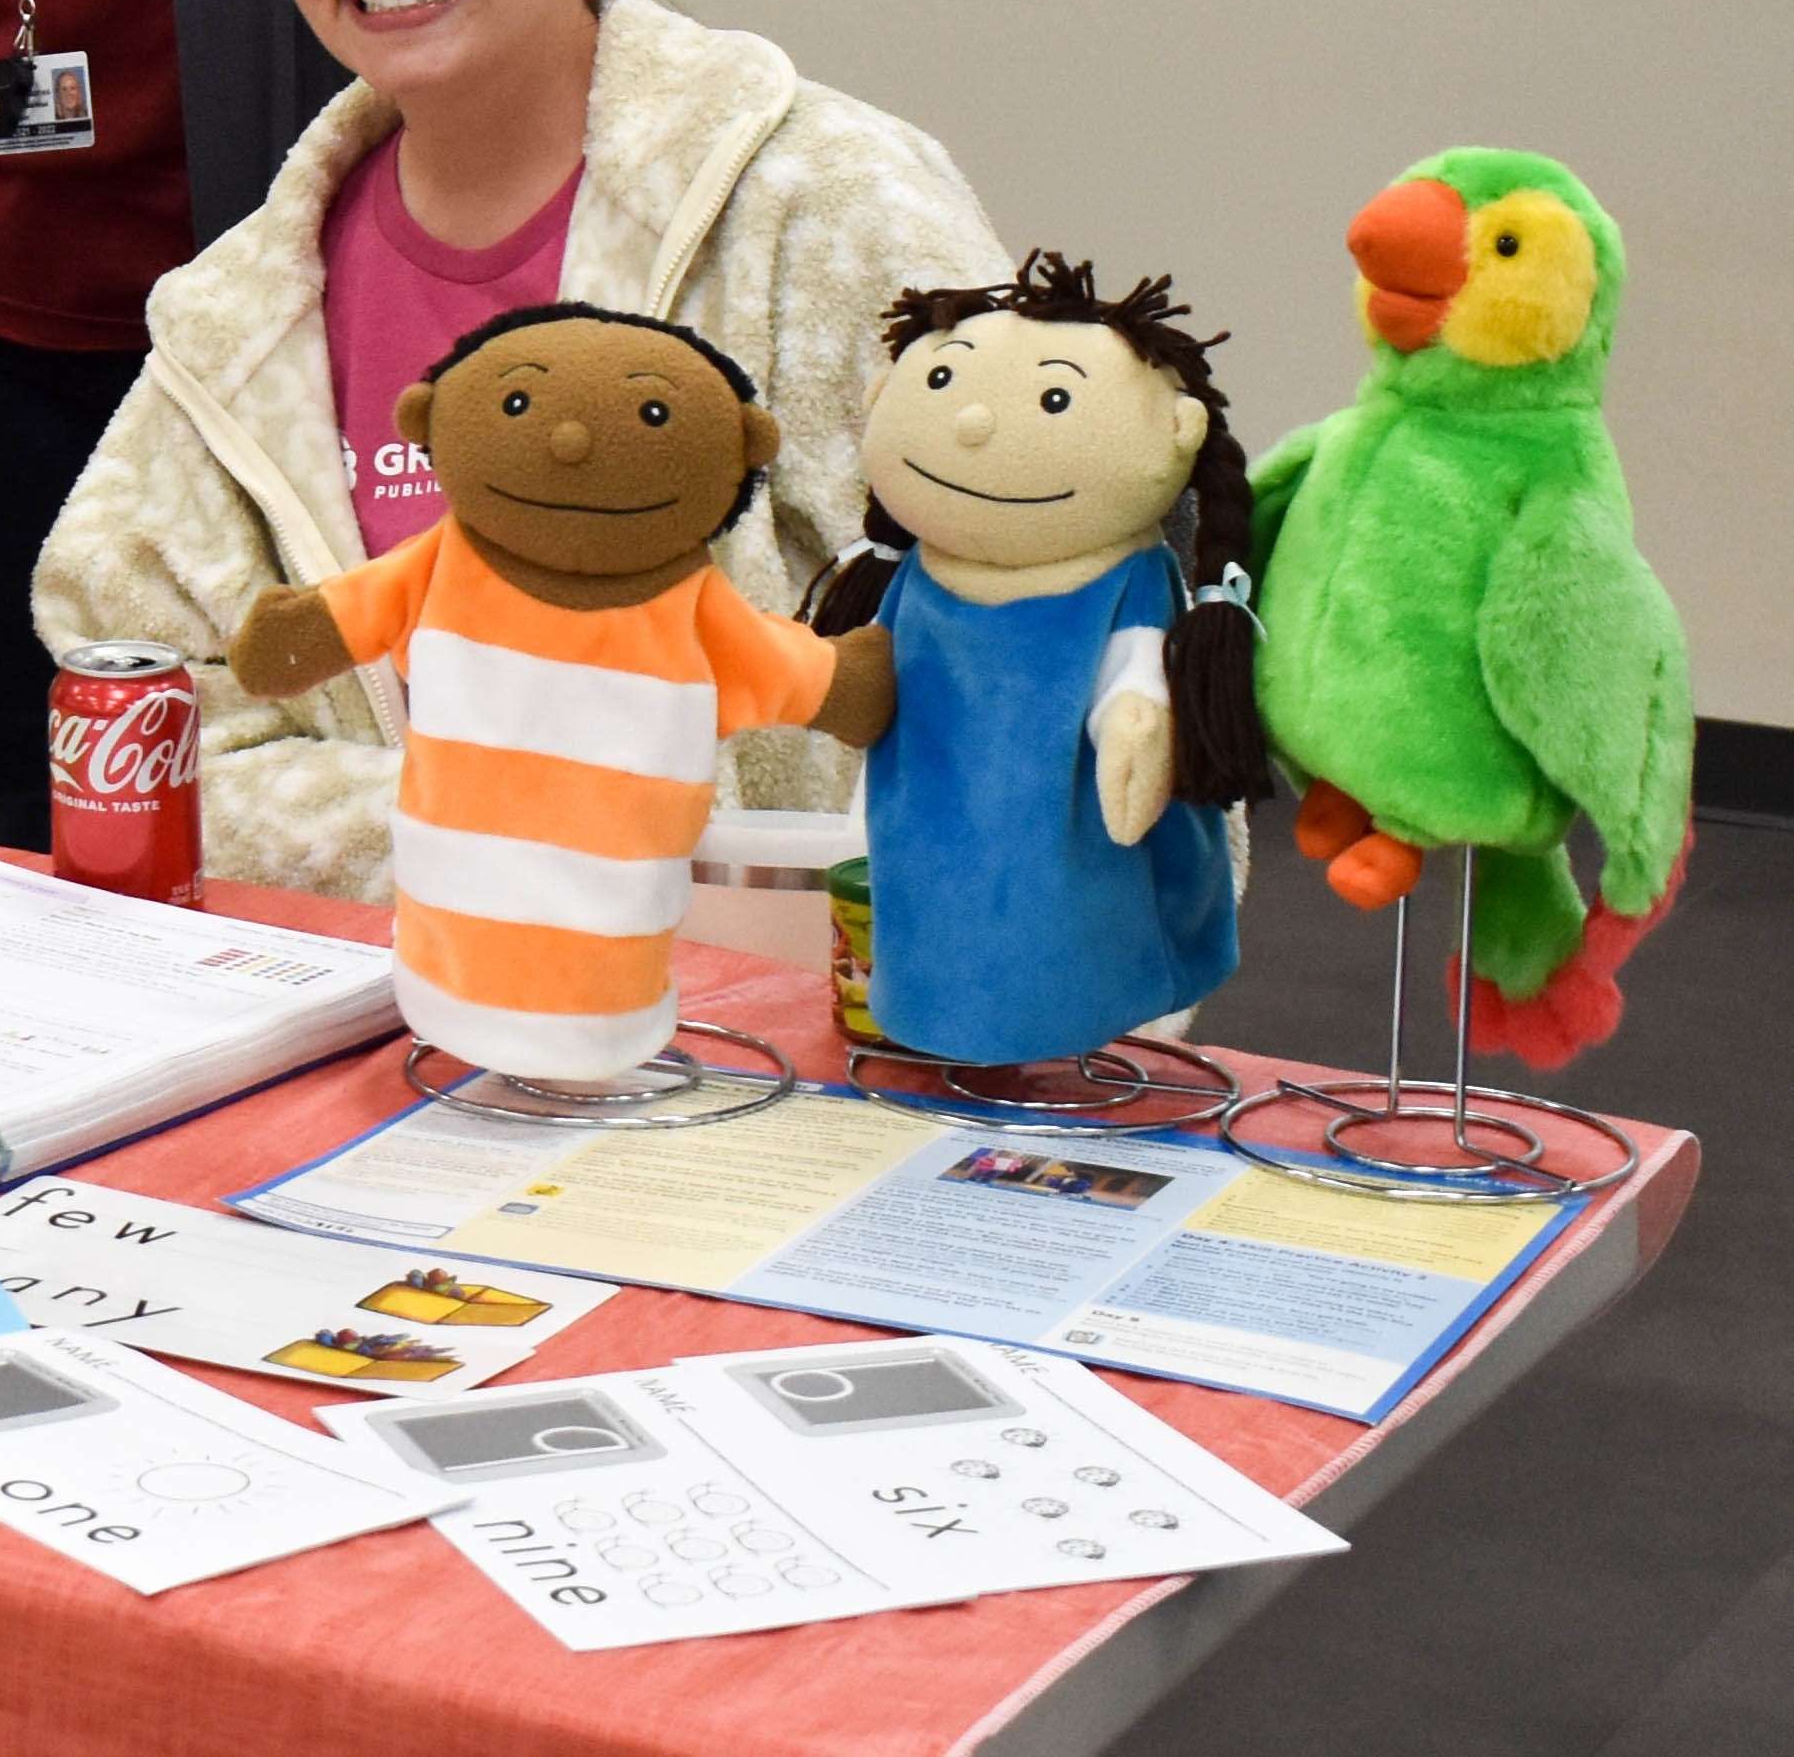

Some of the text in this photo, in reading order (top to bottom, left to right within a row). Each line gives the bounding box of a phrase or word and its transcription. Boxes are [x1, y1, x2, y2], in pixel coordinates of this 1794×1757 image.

[112, 800, 161, 813] TASTE
[1, 1186, 179, 1245] few
[0, 1479, 143, 1544] one
[871, 1485, 980, 1540] six
[473, 1519, 609, 1606] nine
